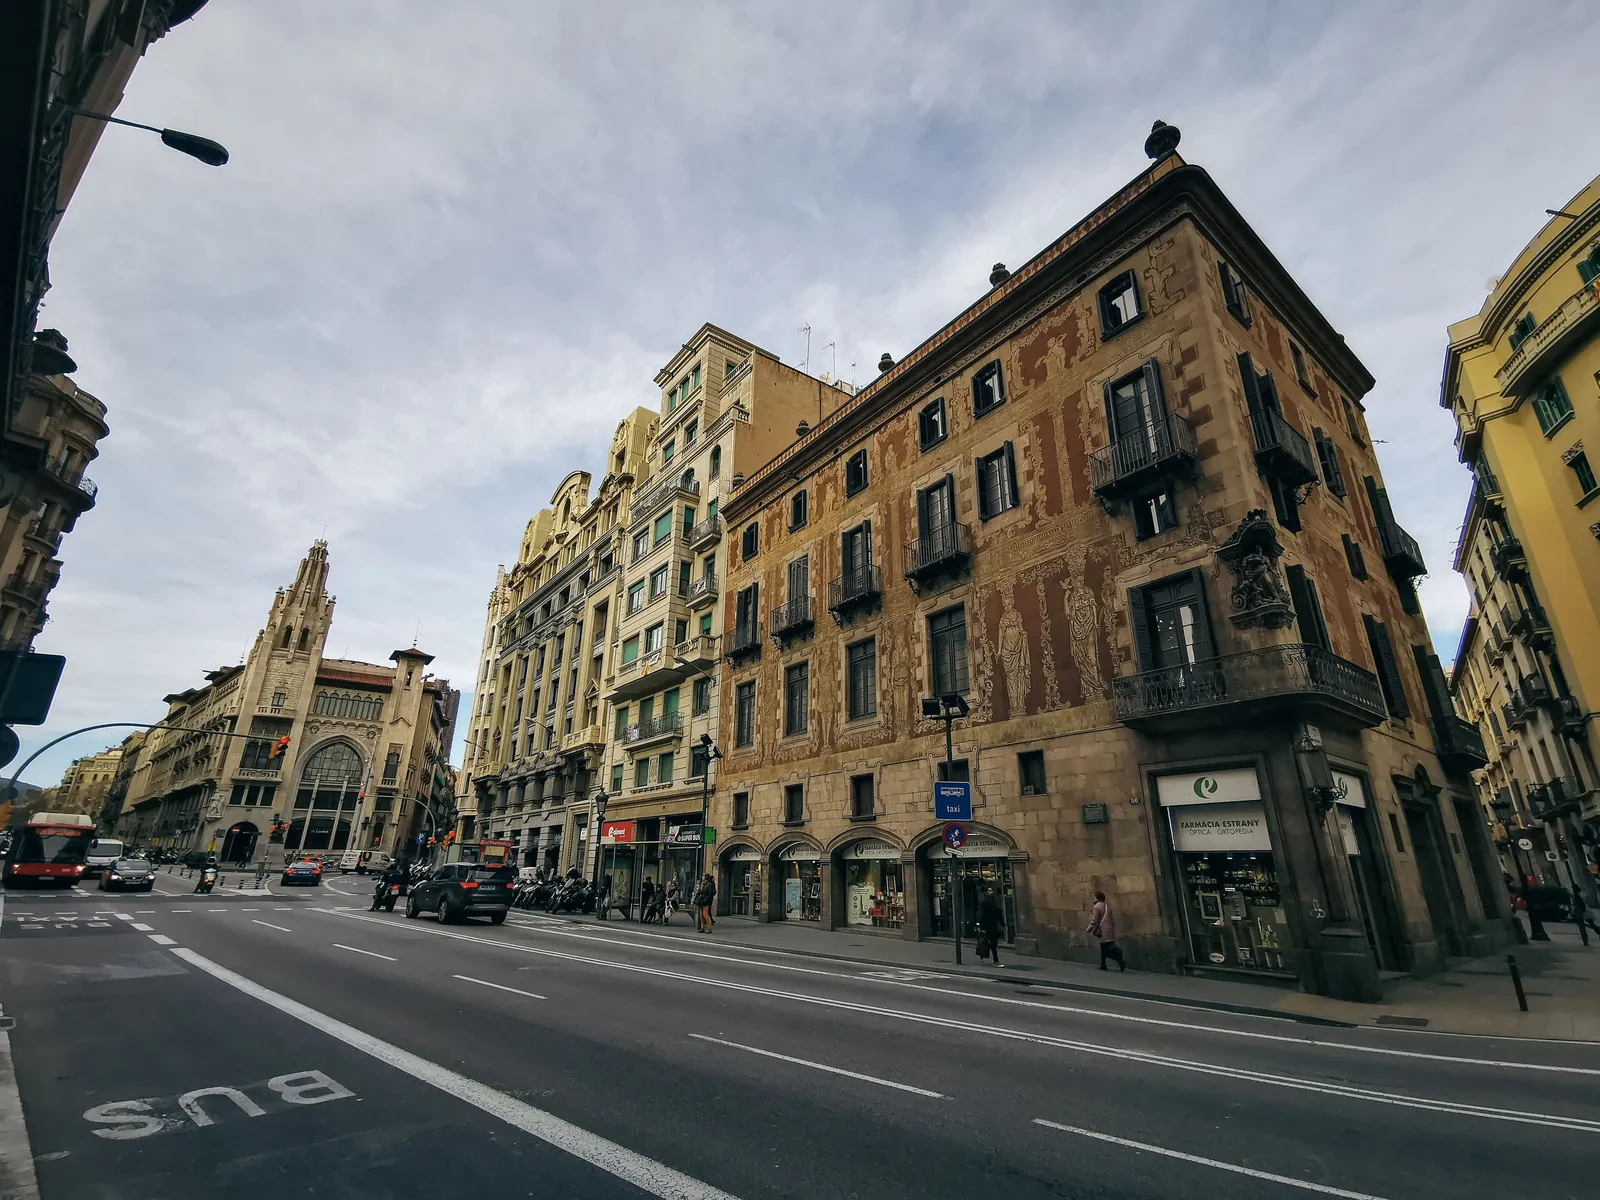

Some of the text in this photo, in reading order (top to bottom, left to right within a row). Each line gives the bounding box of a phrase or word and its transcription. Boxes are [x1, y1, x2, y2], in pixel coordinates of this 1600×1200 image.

[946, 805, 960, 813] taxi
[1181, 819, 1260, 829] FARMÀCIA ESTRANY
[83, 1069, 357, 1140] BUS
